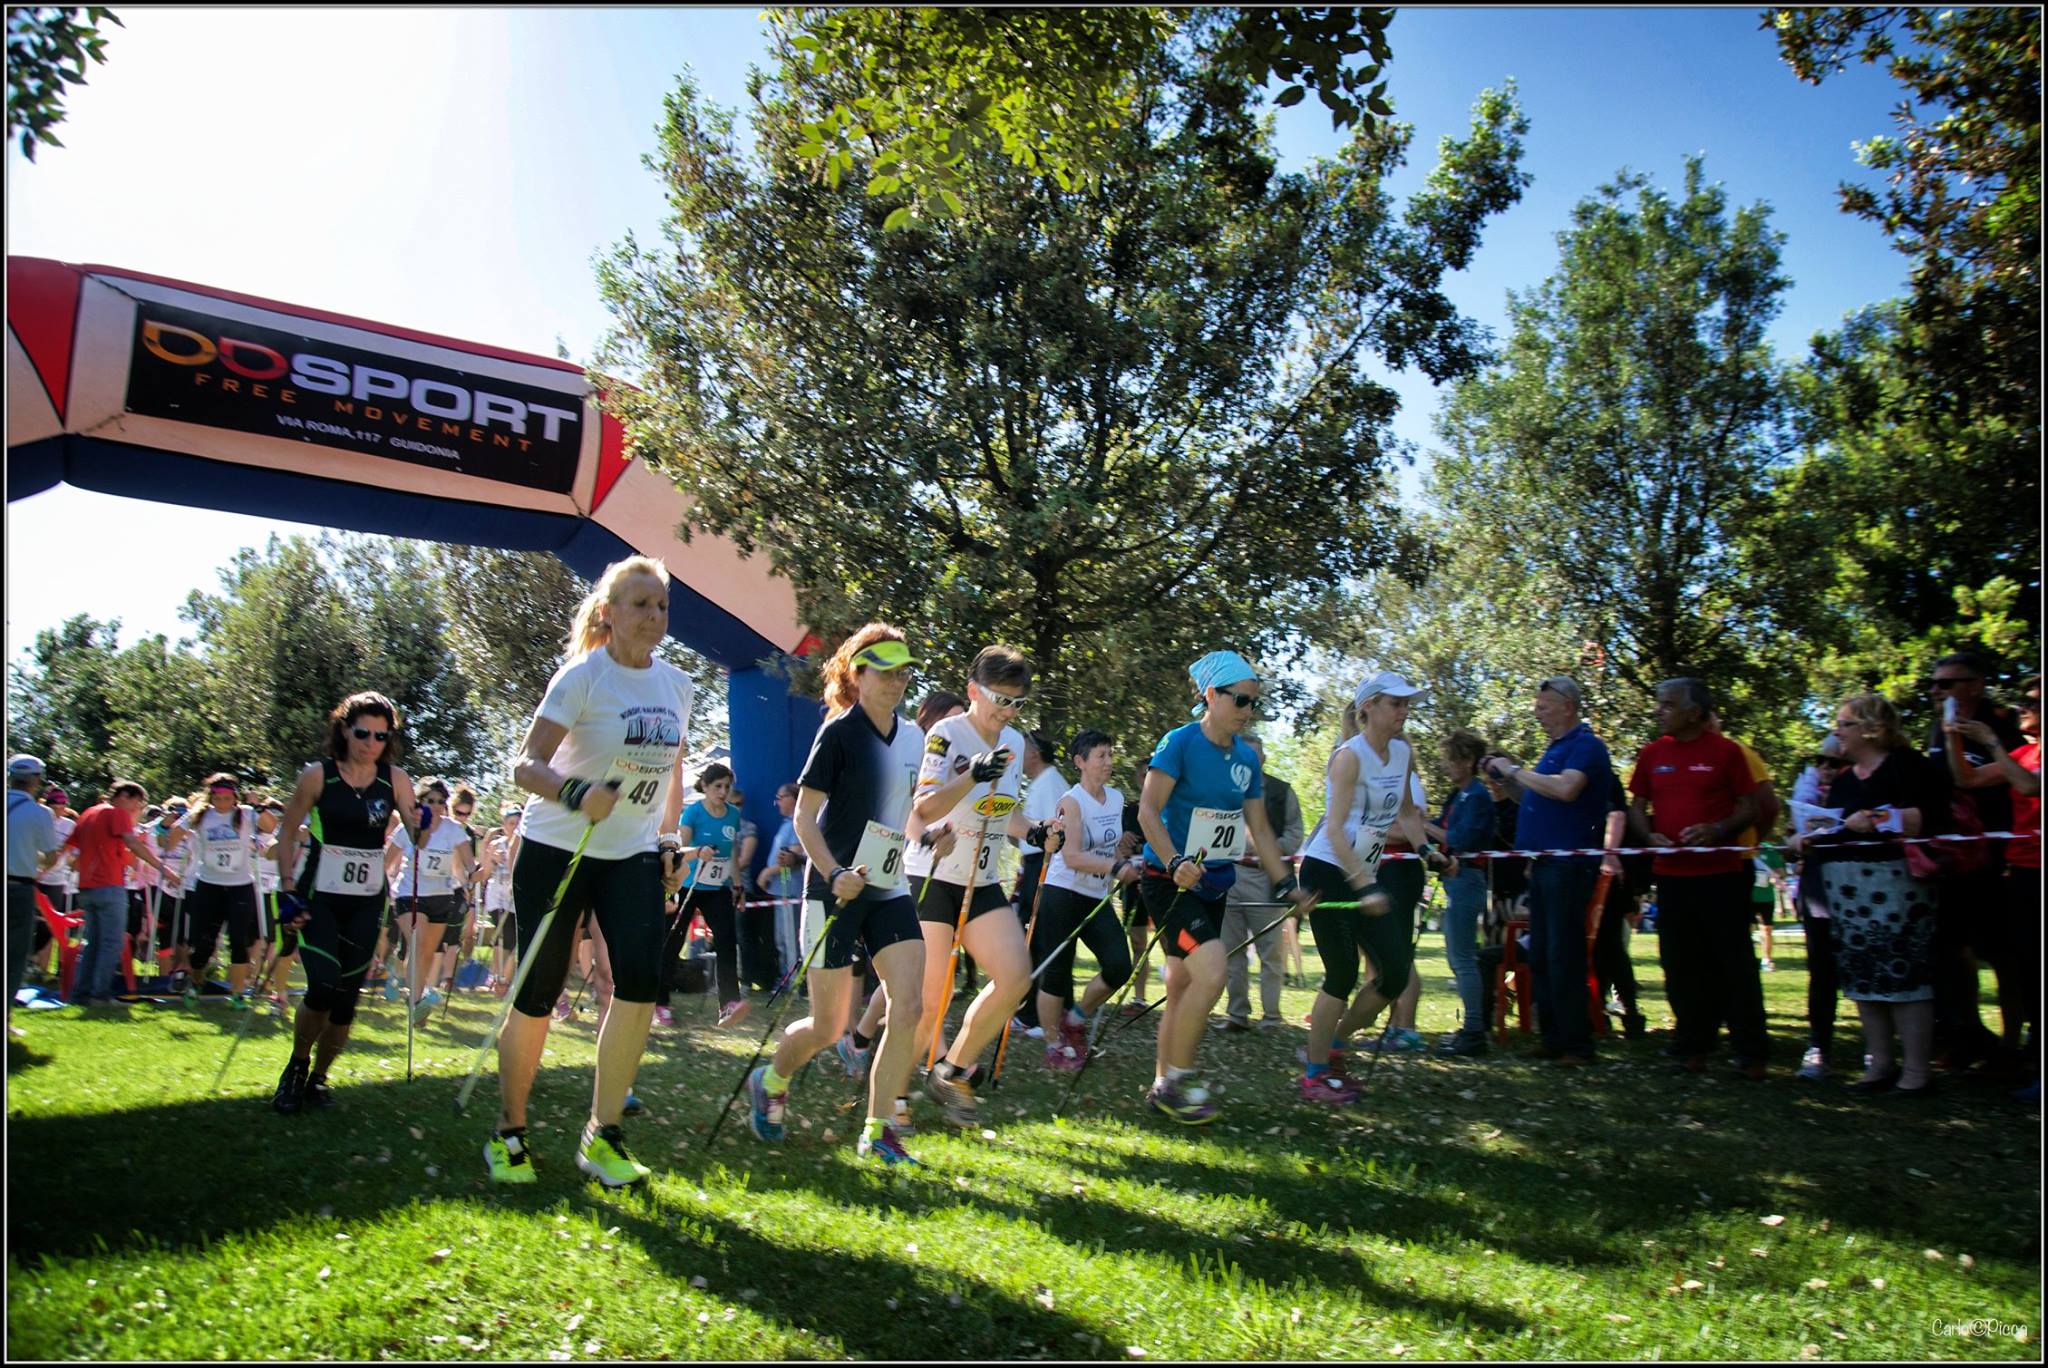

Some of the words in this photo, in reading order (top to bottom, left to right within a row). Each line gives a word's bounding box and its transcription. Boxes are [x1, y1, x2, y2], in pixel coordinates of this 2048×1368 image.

[195, 372, 297, 404] FREE
[334, 400, 533, 451] MOVEMENT
[276, 413, 303, 429] VIA
[389, 436, 461, 460] GUIDONIA
[628, 780, 659, 805] 49
[1211, 825, 1235, 848] 20
[426, 855, 441, 870] 72
[1365, 842, 1383, 864] 21
[343, 862, 370, 884] 86
[710, 865, 724, 879] 31
